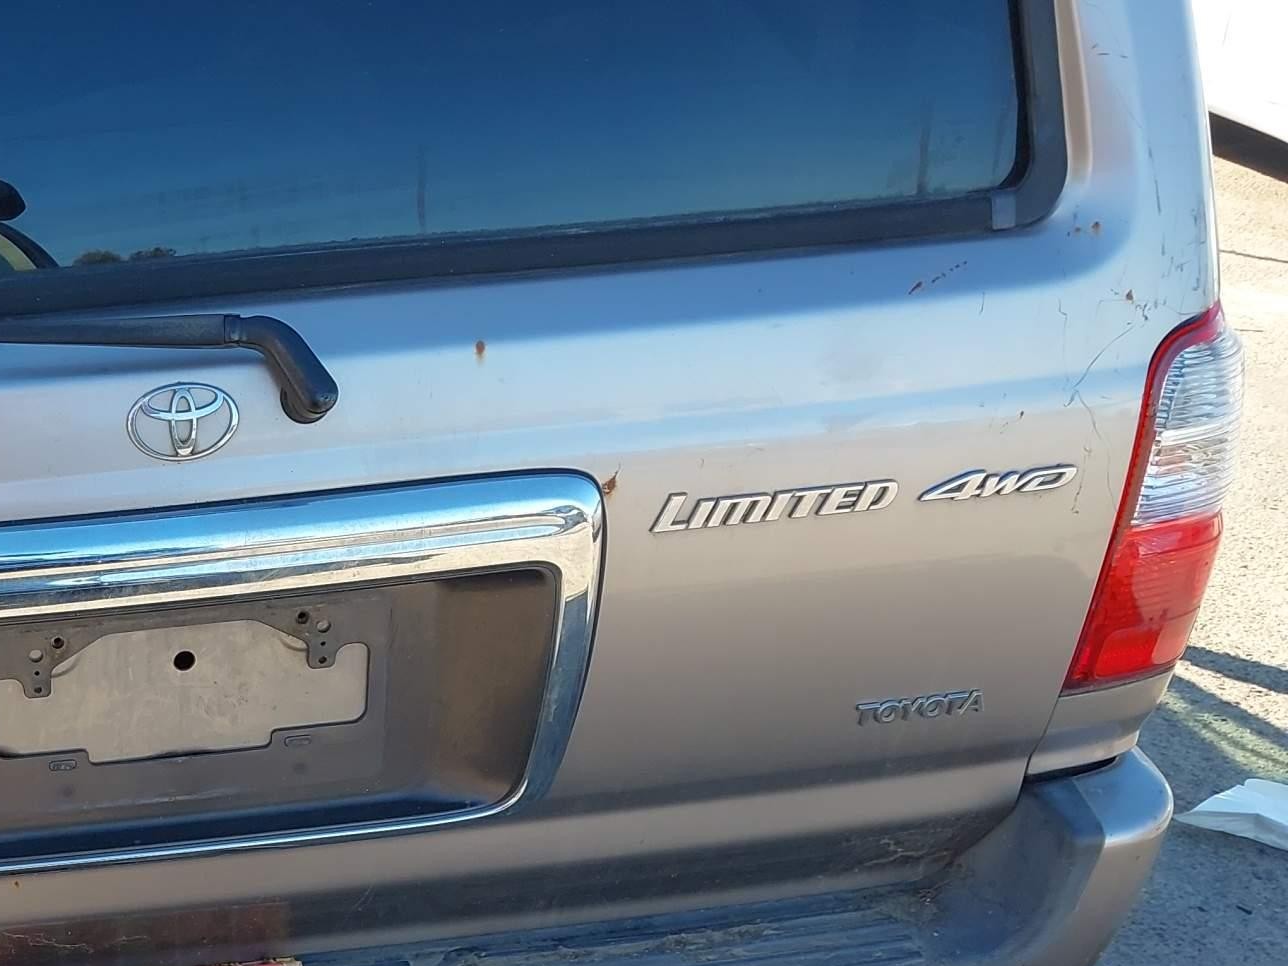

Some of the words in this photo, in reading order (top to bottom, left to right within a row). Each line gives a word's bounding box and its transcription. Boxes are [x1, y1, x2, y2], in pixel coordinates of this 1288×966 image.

[649, 478, 900, 534] LIMITED
[918, 463, 1079, 502] 4WD
[855, 687, 985, 726] TOYOTA
